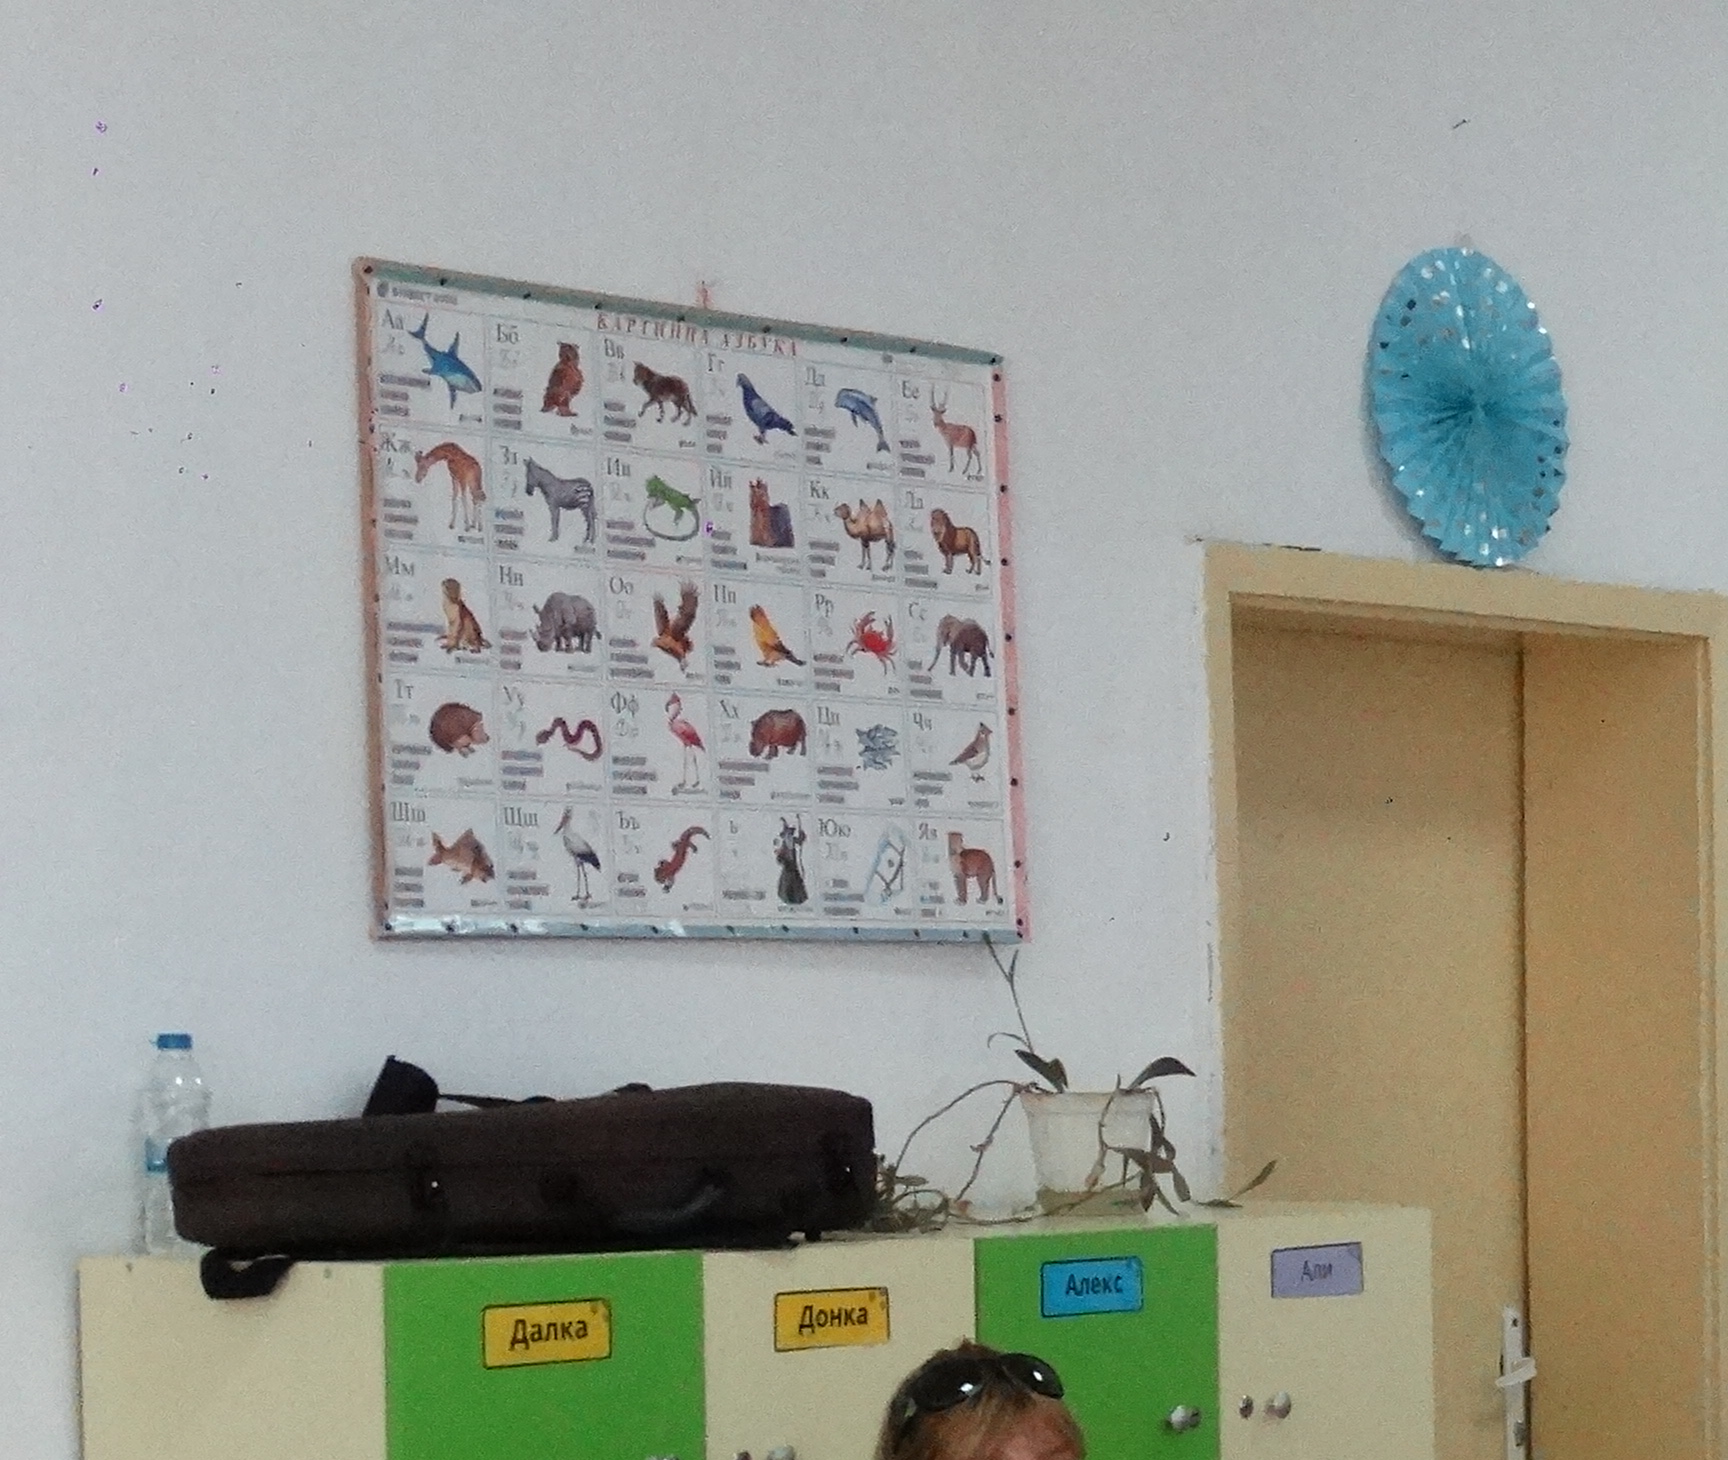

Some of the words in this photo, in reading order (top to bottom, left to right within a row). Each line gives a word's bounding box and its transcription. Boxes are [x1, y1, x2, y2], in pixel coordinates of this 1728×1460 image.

[1065, 1271, 1123, 1297] Алекс
[507, 1318, 589, 1352] Далка
[798, 1304, 869, 1335] Донка
